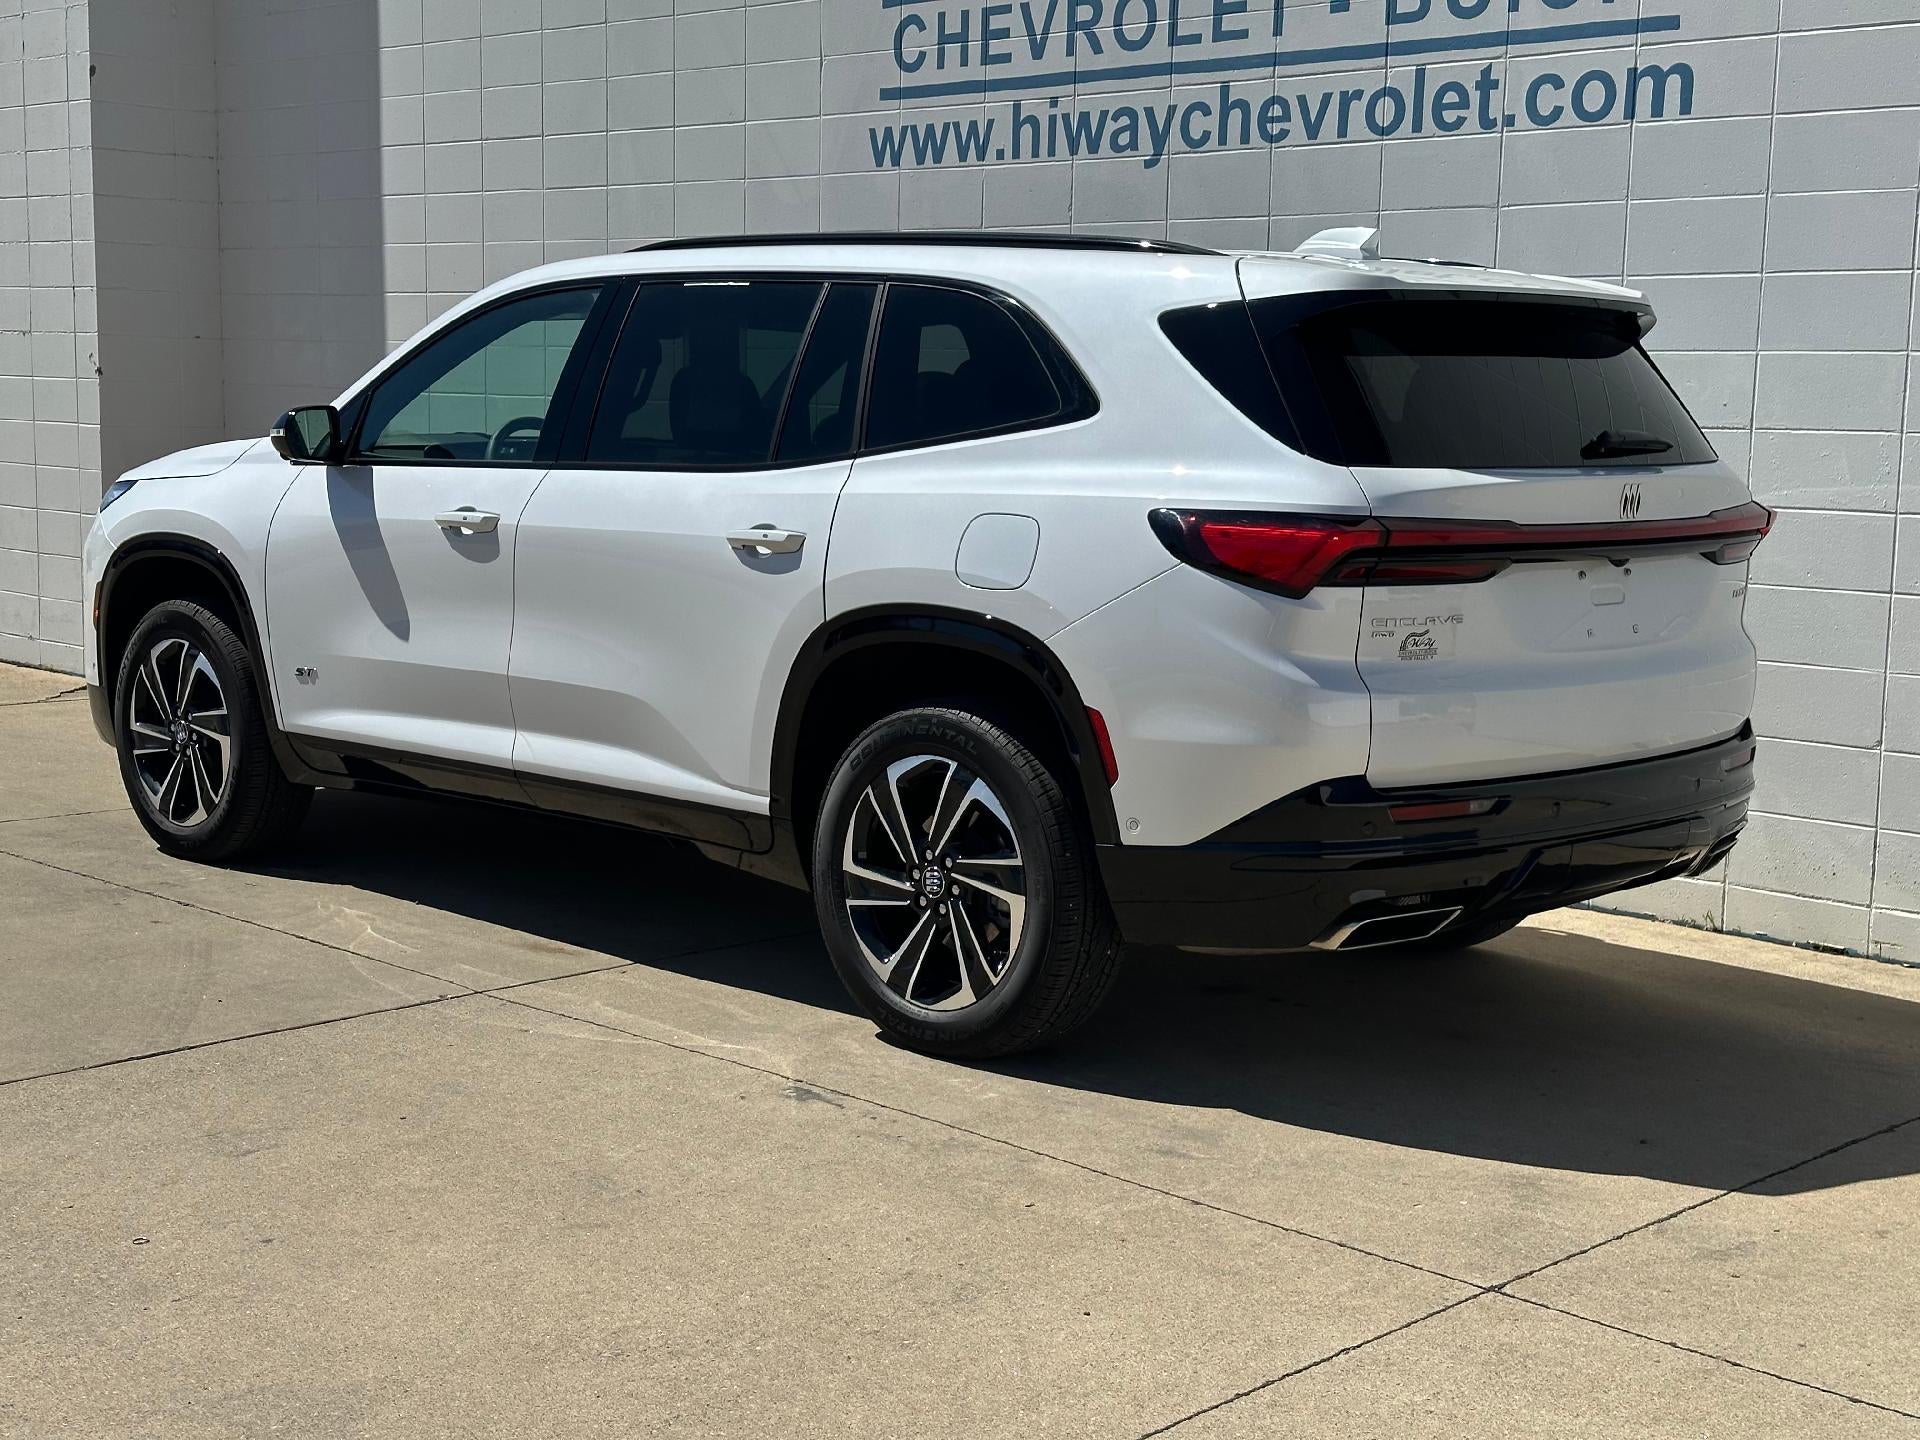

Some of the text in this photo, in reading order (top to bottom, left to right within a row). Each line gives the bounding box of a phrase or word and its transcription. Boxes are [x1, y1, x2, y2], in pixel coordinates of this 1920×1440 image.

[868, 62, 1694, 169] www.hiwaychevrolet.com
[1371, 614, 1464, 628] ENCLAVE
[294, 667, 318, 678] ST
